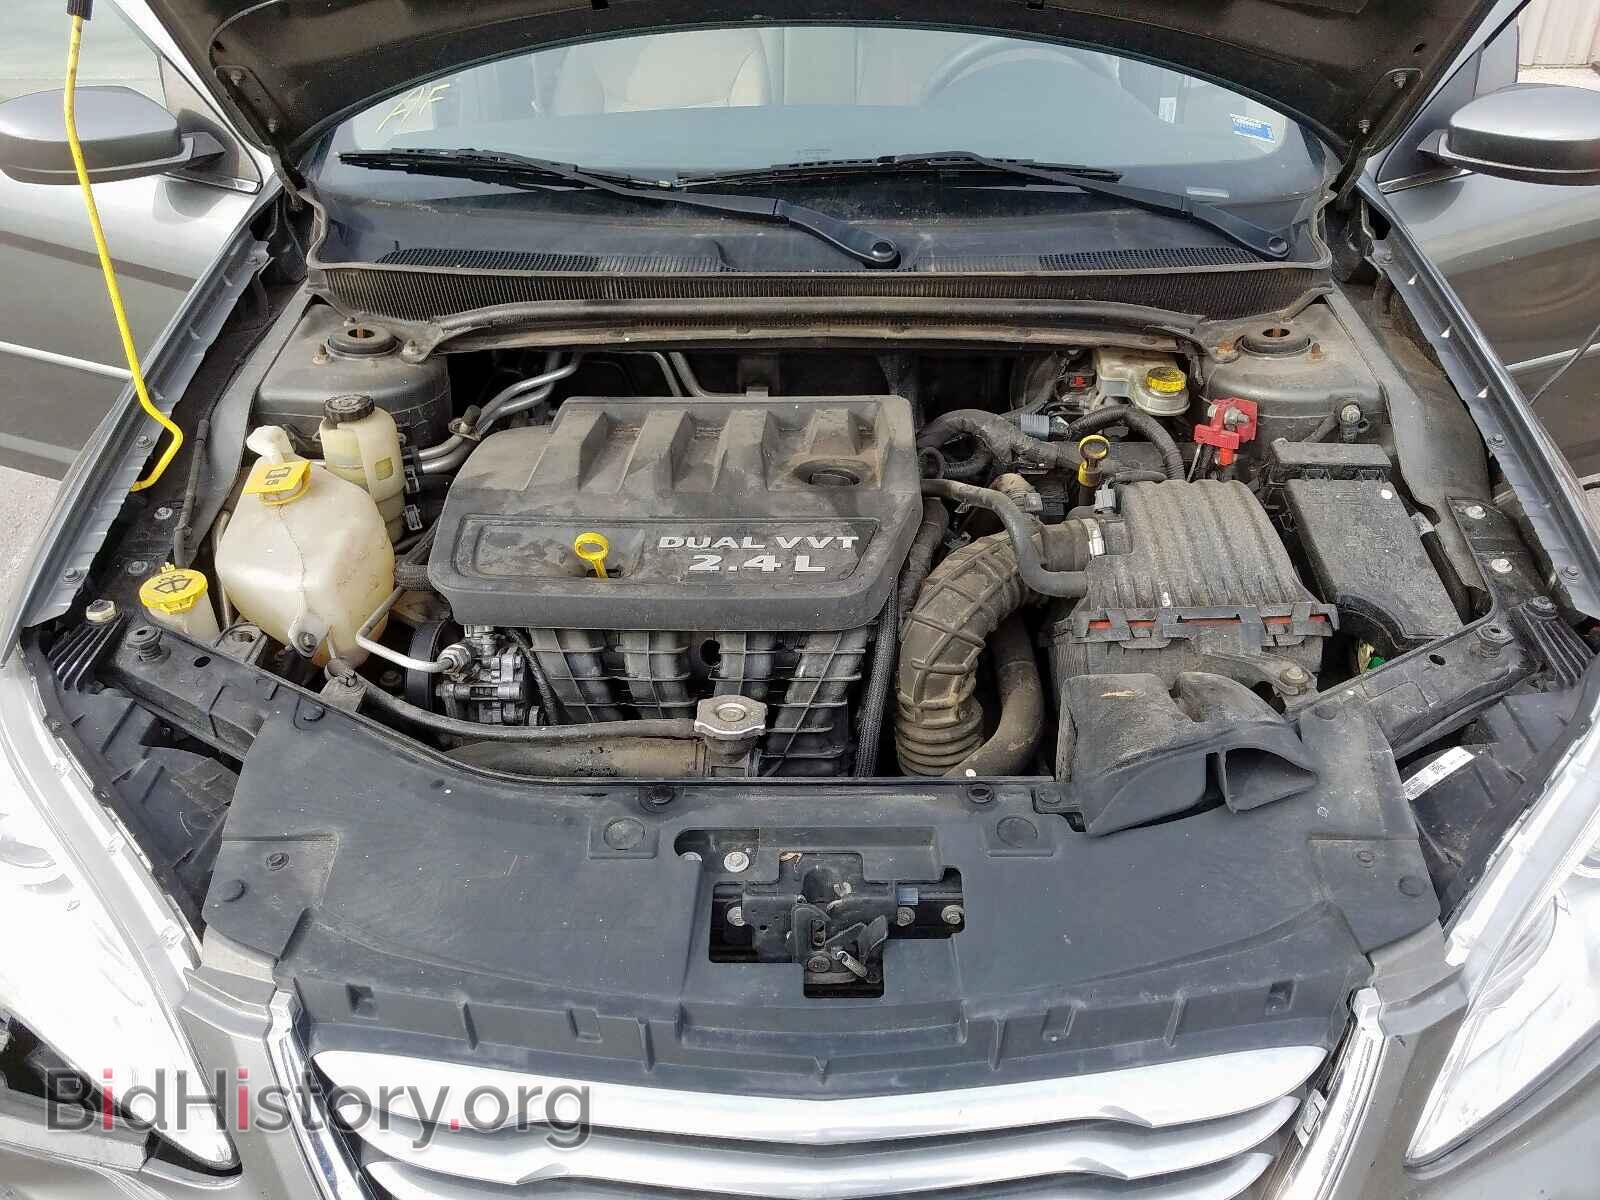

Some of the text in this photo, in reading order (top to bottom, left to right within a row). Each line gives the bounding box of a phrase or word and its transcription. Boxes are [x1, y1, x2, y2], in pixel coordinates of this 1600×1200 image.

[658, 536, 860, 549] DUAL VVT
[688, 554, 782, 572] 2.4
